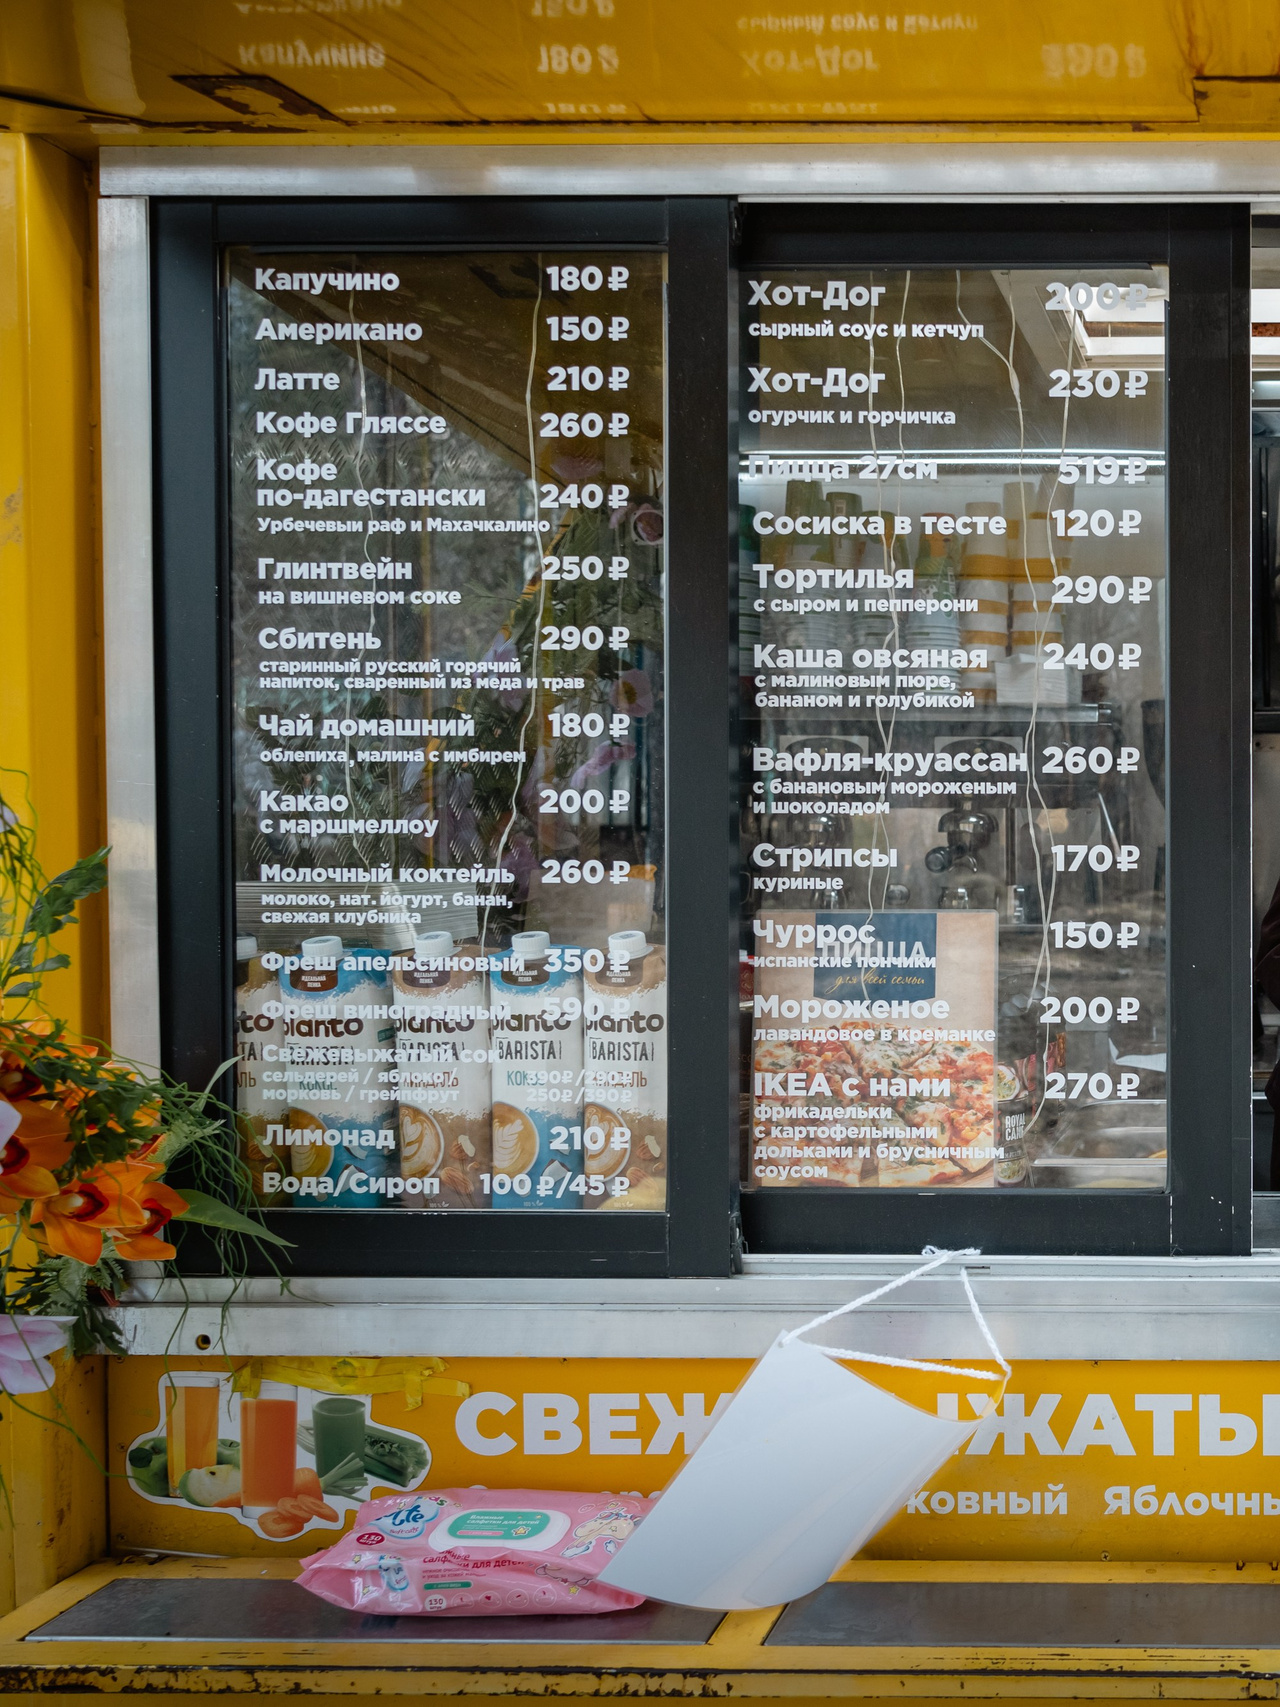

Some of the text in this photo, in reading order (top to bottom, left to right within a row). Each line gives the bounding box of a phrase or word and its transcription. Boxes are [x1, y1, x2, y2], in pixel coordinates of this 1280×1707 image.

[255, 267, 399, 295] Капучино
[748, 281, 886, 310] Хот-Дог
[255, 318, 422, 344] Американо
[748, 320, 984, 340] сырный соус и кетчуп
[254, 369, 340, 390] Латте
[748, 368, 886, 397] Хот-Дог
[256, 412, 337, 437] Кофе
[346, 412, 446, 434] Гляссе
[257, 458, 337, 484] Кофе
[859, 456, 937, 481] 27см
[257, 488, 485, 509] по-дагестански
[753, 512, 885, 535] Сосиска
[895, 517, 911, 534] в
[920, 516, 1007, 535] тесте
[258, 557, 412, 580] Глинтвейн
[753, 565, 914, 593] Тортилья
[258, 627, 381, 650] Сбитень
[260, 659, 520, 675] старинный русский горячий
[754, 645, 843, 669] Каша
[853, 650, 988, 669] овсяная
[260, 674, 584, 691] напиток, сваренный из меда и трав
[753, 747, 1027, 775] Вафля-круассан
[753, 843, 897, 870] Стрипсы
[261, 863, 392, 883] Молочный
[399, 864, 515, 884] коктейль
[754, 876, 843, 891] куриные
[261, 890, 513, 908] молоко, нат. йогурт, банан,
[262, 909, 421, 924] свежая клубника
[753, 920, 875, 949] Чуррос
[261, 951, 336, 975] Фреш
[343, 953, 524, 972] апельсиновый
[754, 995, 950, 1023] Мороженое
[754, 1028, 995, 1043] лавандовое в креманке
[592, 1041, 649, 1061] BARISTA
[754, 1072, 832, 1096] IKEA
[842, 1080, 860, 1097] с
[870, 1080, 950, 1096] нами
[754, 1104, 892, 1121] фрикадельки
[263, 1125, 395, 1150] Лимонад
[263, 1168, 440, 1196] Вода/Сироп
[755, 1165, 828, 1181] соусом
[907, 1483, 1068, 1515] ковный
